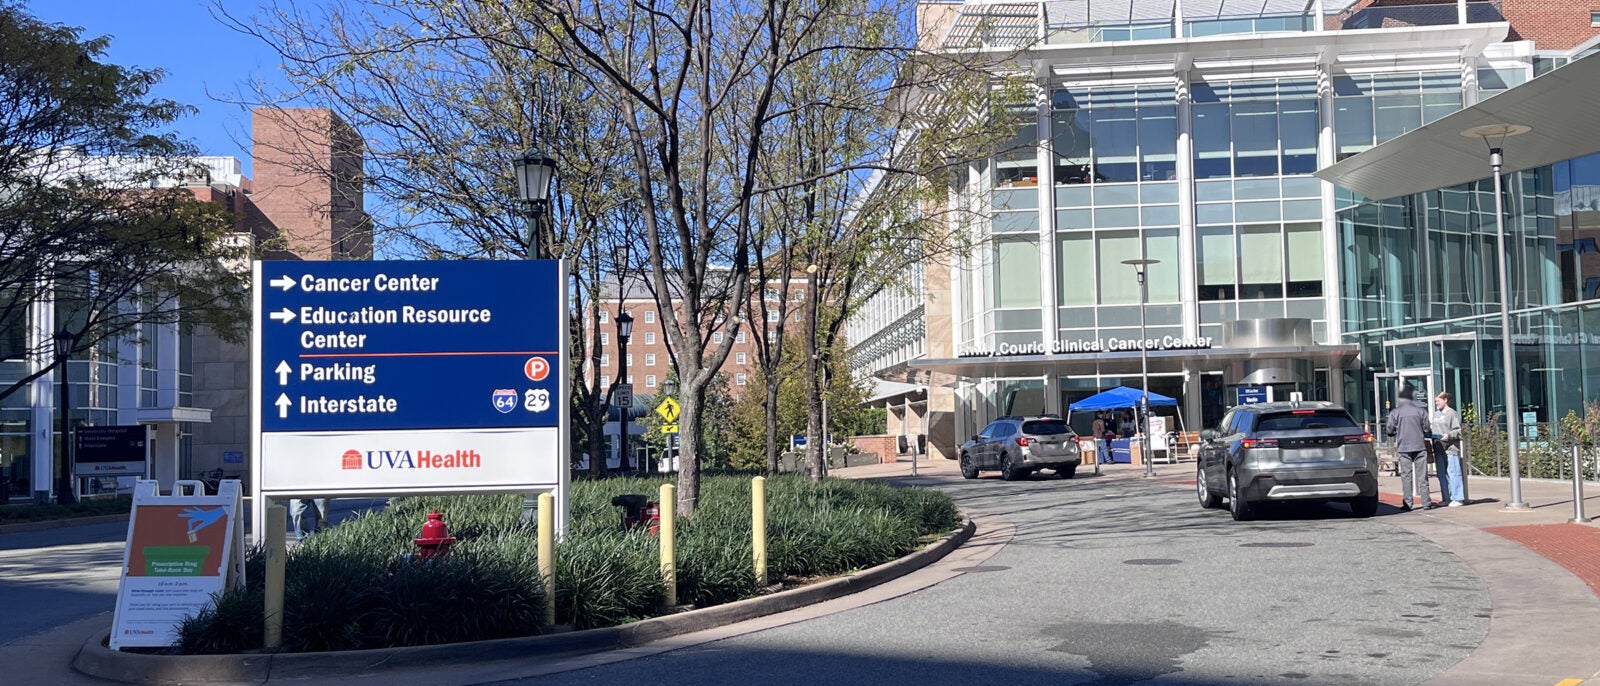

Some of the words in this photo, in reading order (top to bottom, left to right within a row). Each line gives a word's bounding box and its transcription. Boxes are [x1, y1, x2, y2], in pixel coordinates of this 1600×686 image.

[300, 273, 370, 292] Cancer
[374, 273, 439, 292] Center
[300, 306, 398, 325] Education
[402, 305, 491, 324] Resource
[300, 330, 367, 349] Center
[999, 341, 1044, 355] Couric
[1052, 338, 1104, 353] Clinical
[1108, 337, 1160, 350] Cancer
[1163, 335, 1212, 348] Center
[300, 362, 376, 384] Parking
[529, 361, 545, 377] P
[300, 395, 398, 414] Interstate
[496, 396, 514, 408] 64
[527, 393, 547, 407] 29
[617, 396, 630, 406] 15
